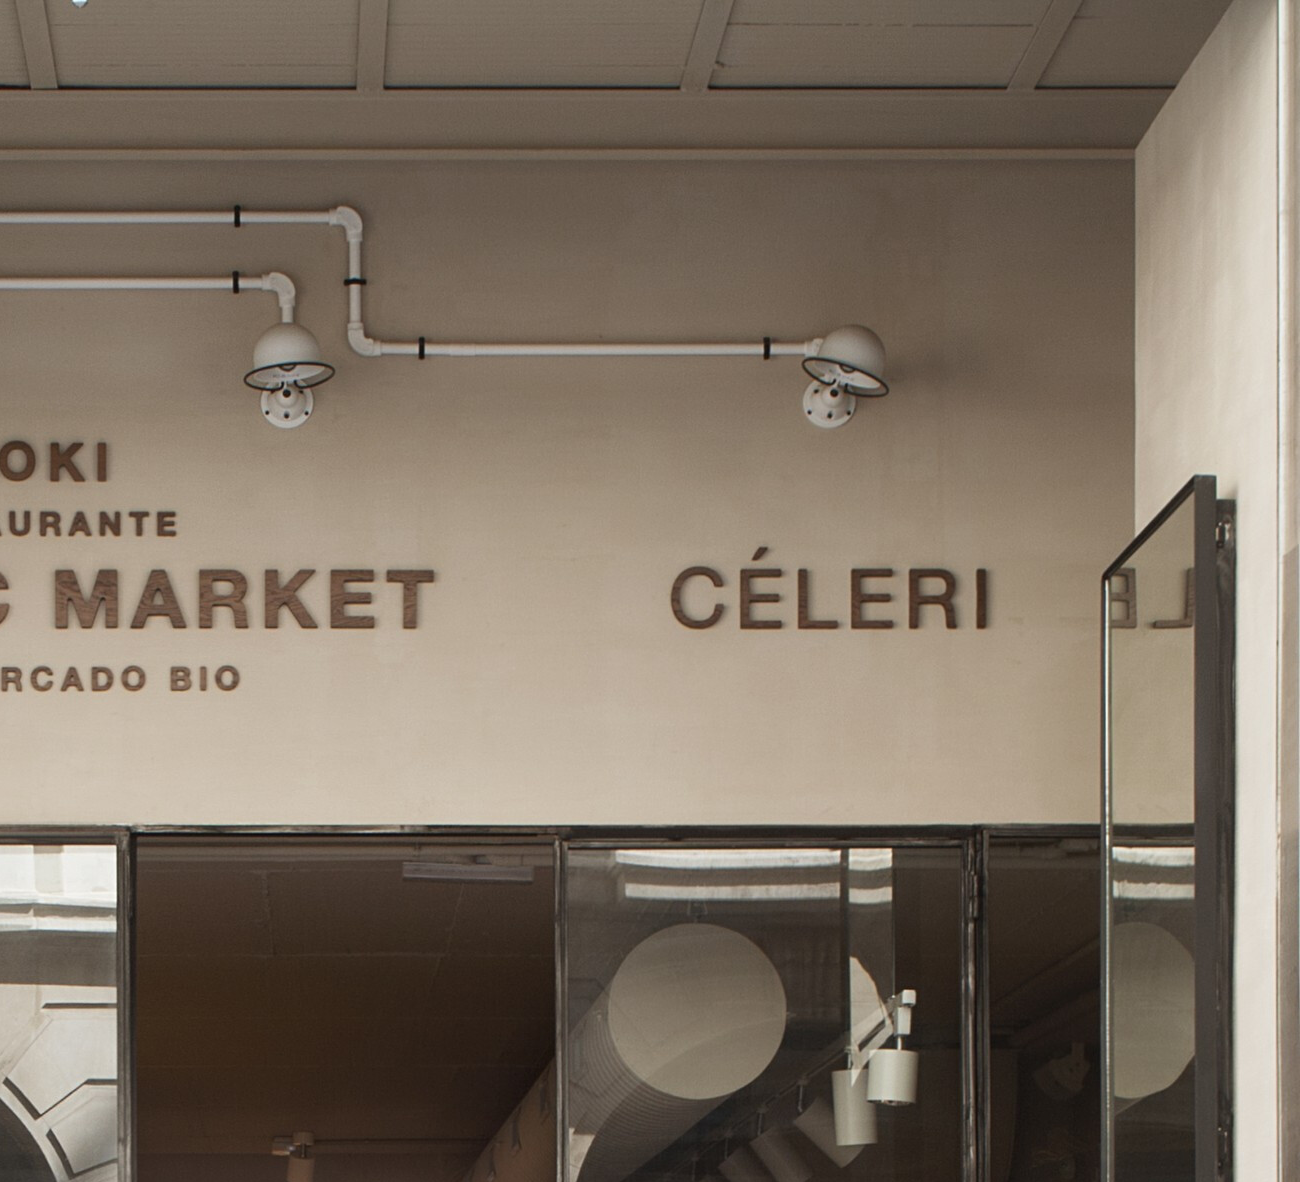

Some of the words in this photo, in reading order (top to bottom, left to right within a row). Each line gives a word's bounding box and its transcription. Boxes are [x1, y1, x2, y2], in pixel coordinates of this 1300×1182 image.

[54, 568, 437, 630] MARKET
[670, 546, 991, 630] CÉLERI
[169, 665, 241, 693] BIO
